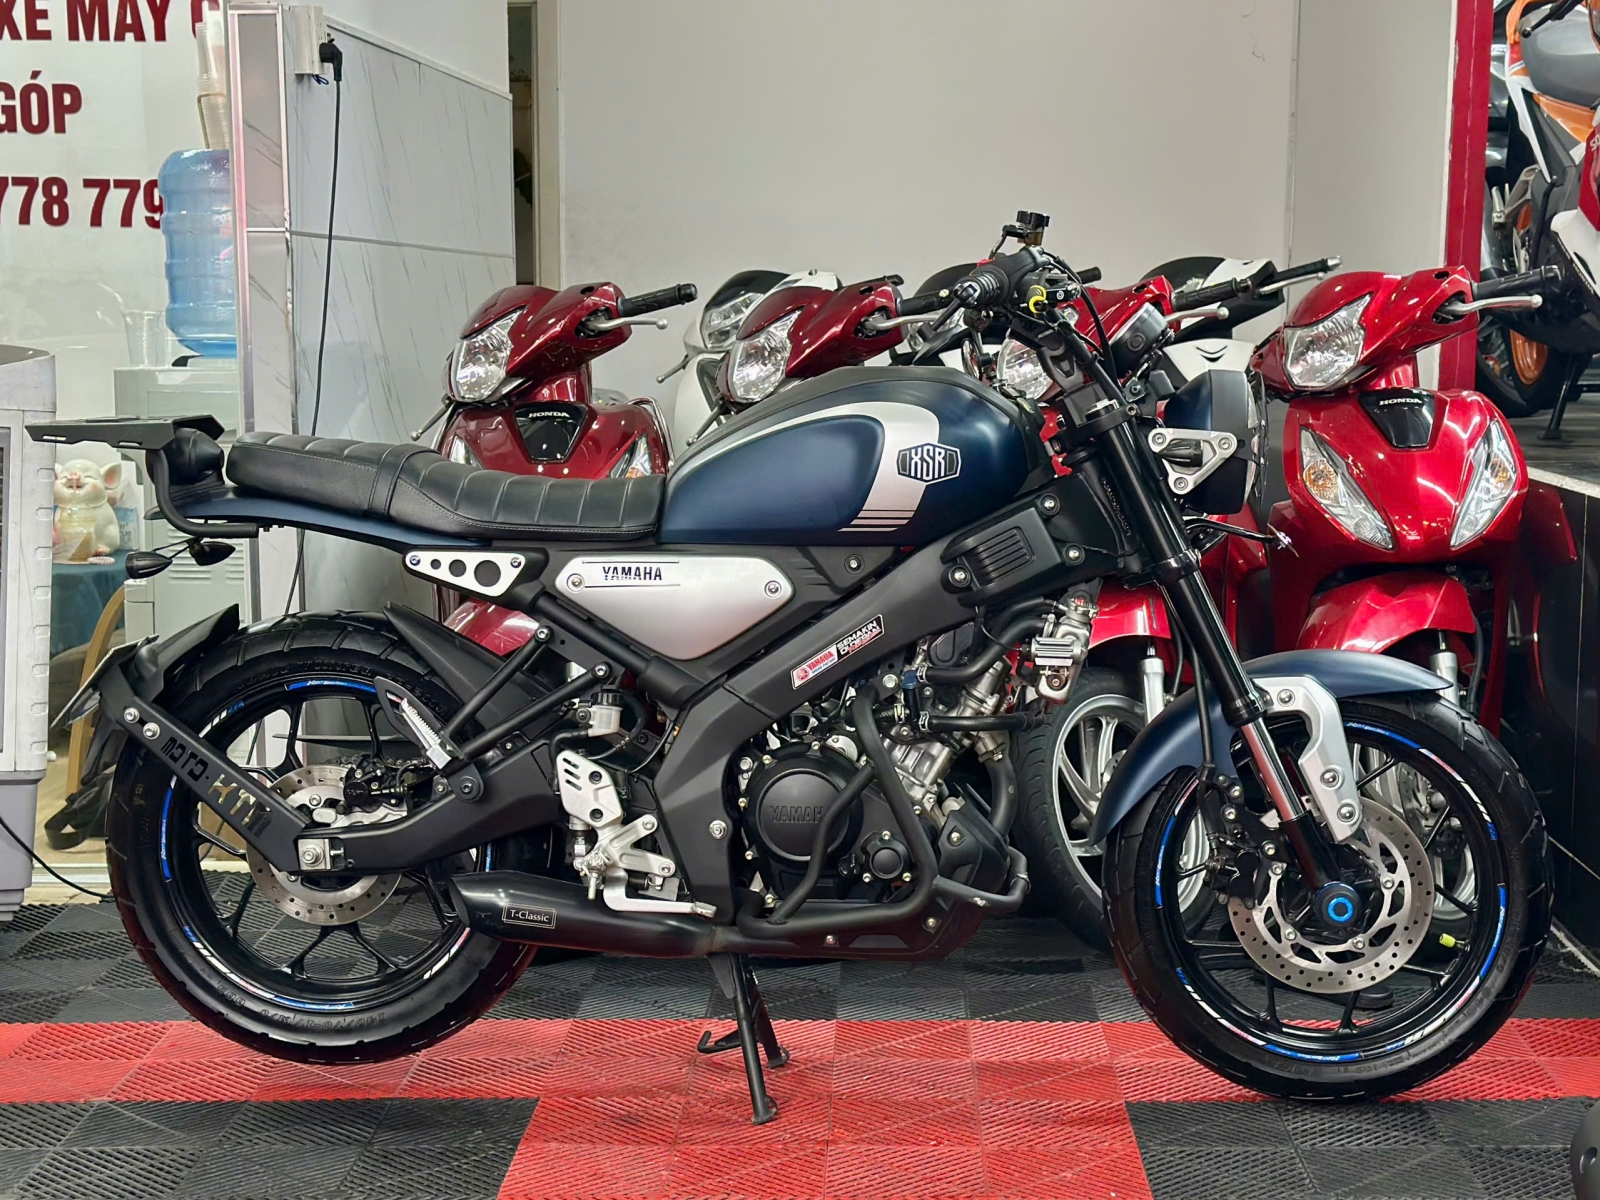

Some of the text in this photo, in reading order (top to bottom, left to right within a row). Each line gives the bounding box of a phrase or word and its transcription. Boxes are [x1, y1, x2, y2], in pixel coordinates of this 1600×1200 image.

[1379, 397, 1423, 406] HONDA
[910, 445, 946, 481] XSR
[602, 566, 663, 581] YAMAHA
[836, 620, 877, 649] SEMAKIN
[769, 805, 825, 824] YAMAH
[510, 909, 550, 922] T-Classic
